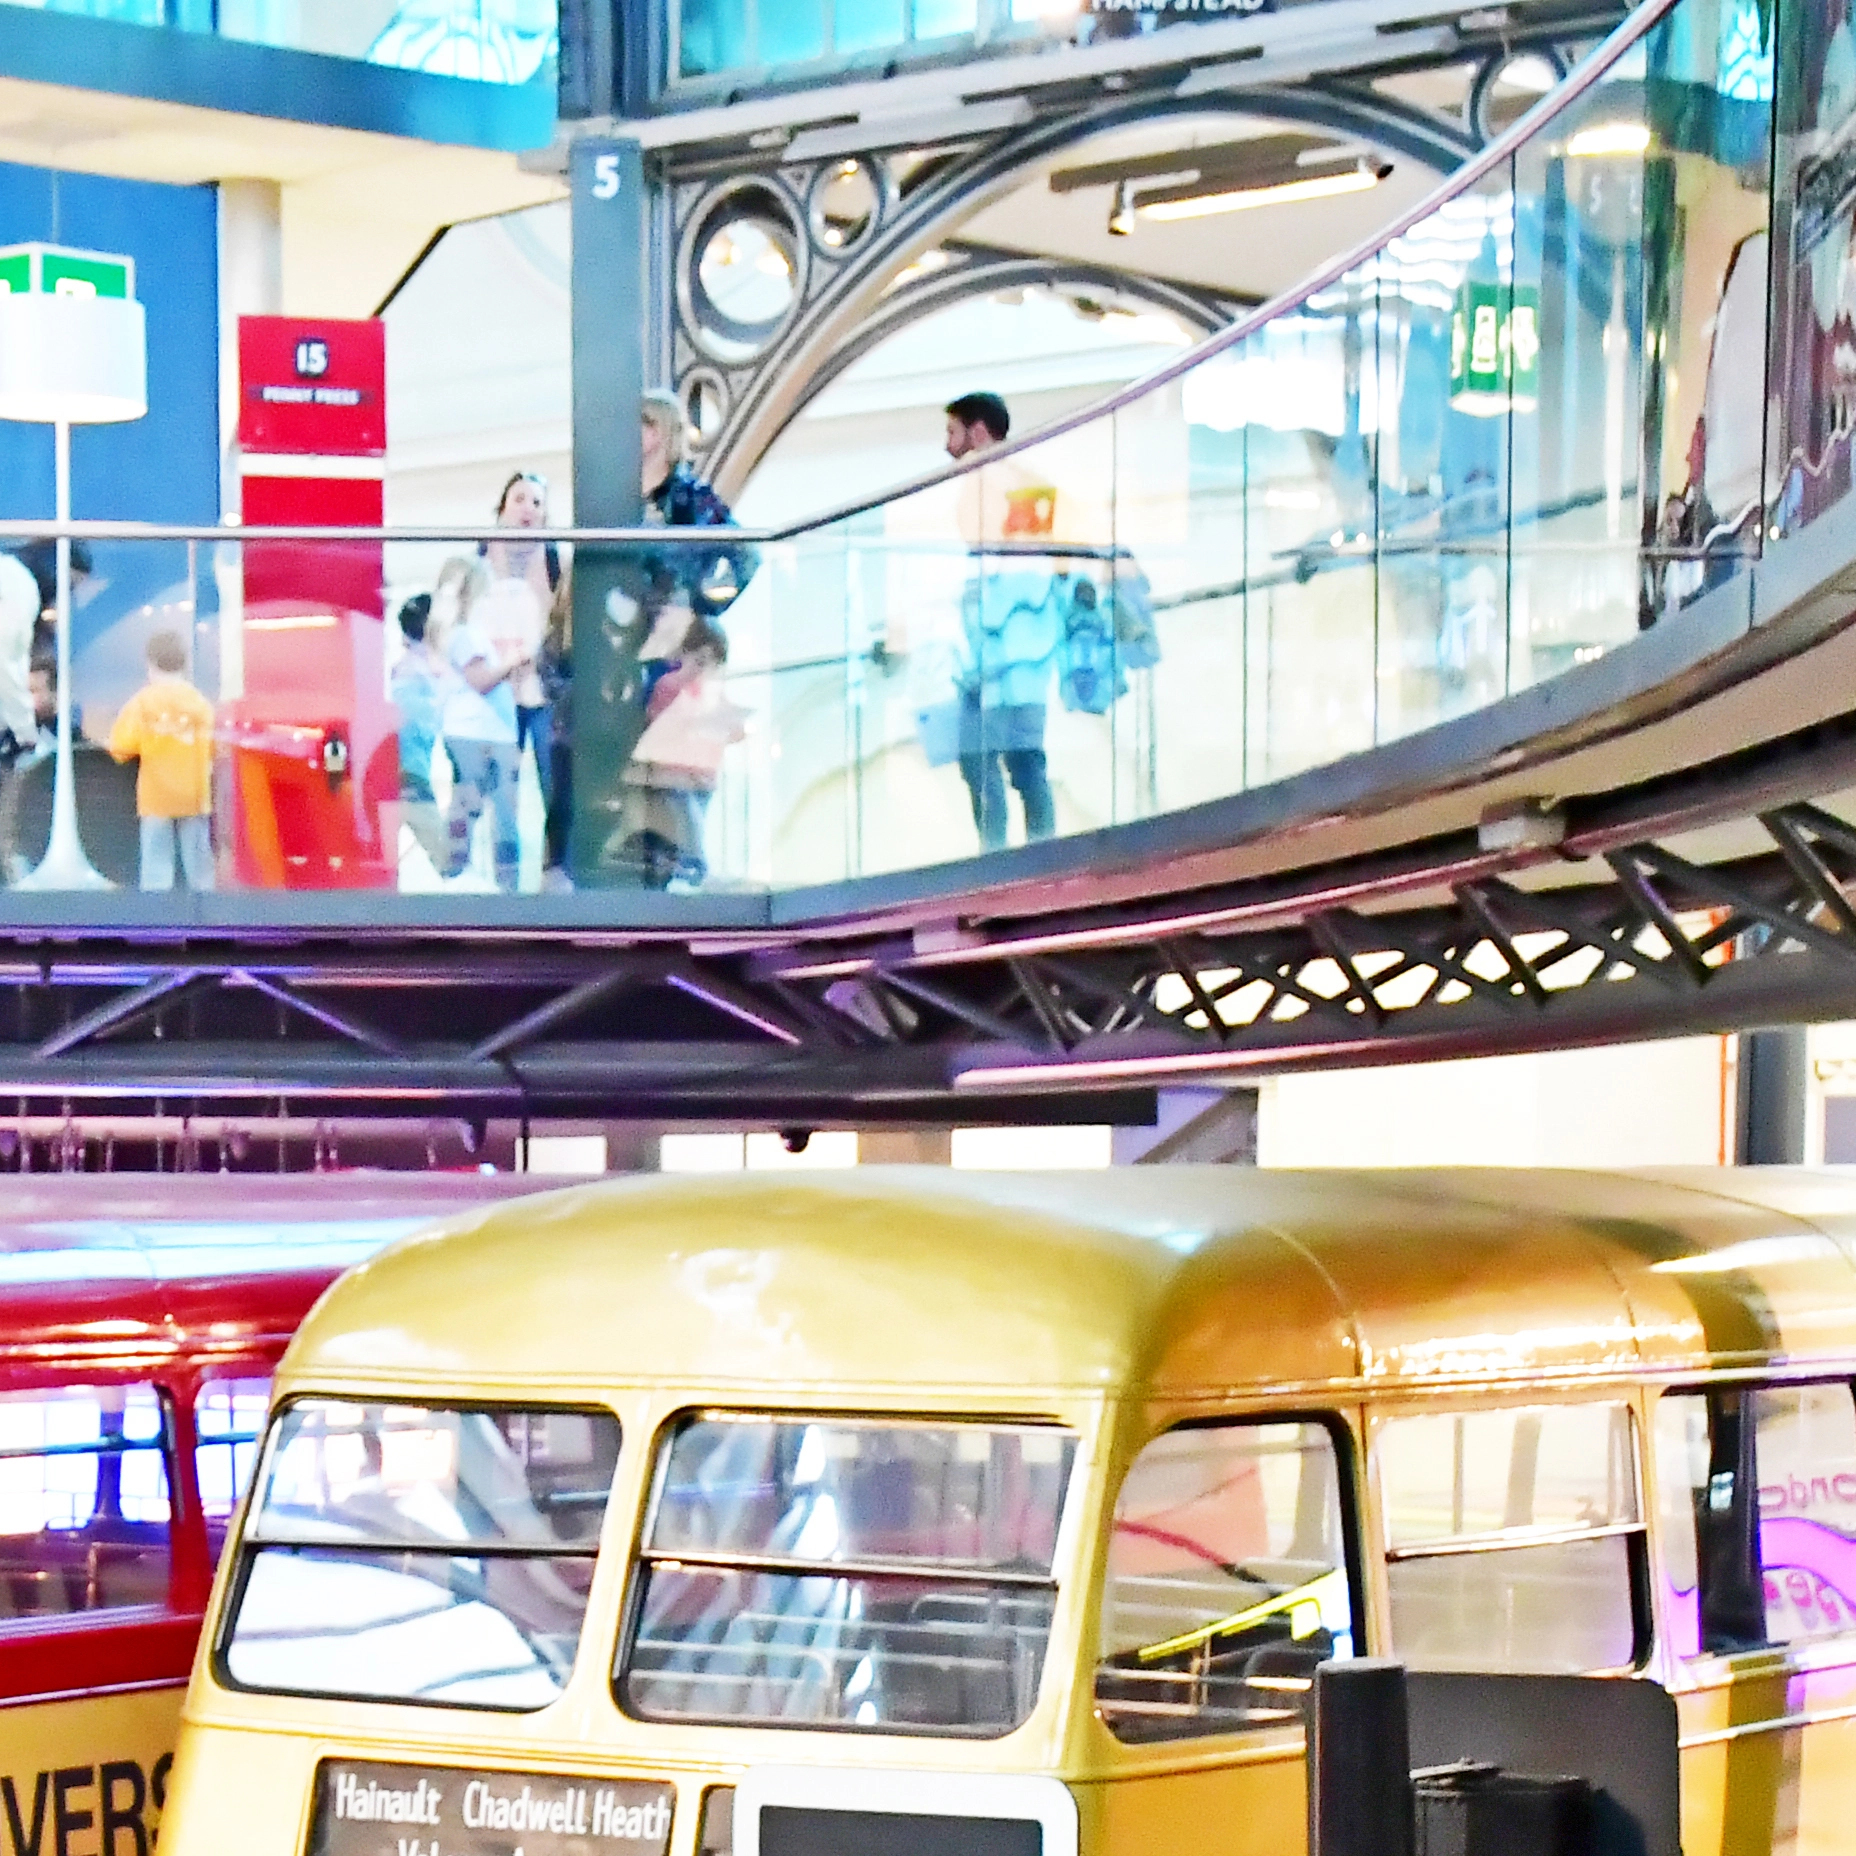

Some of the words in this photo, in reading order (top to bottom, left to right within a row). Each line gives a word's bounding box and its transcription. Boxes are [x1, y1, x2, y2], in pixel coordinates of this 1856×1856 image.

[591, 153, 621, 200] 5
[296, 342, 328, 374] 15
[335, 1772, 442, 1825] Hainault
[462, 1779, 587, 1835] Chadwell
[592, 1789, 671, 1841] Heath
